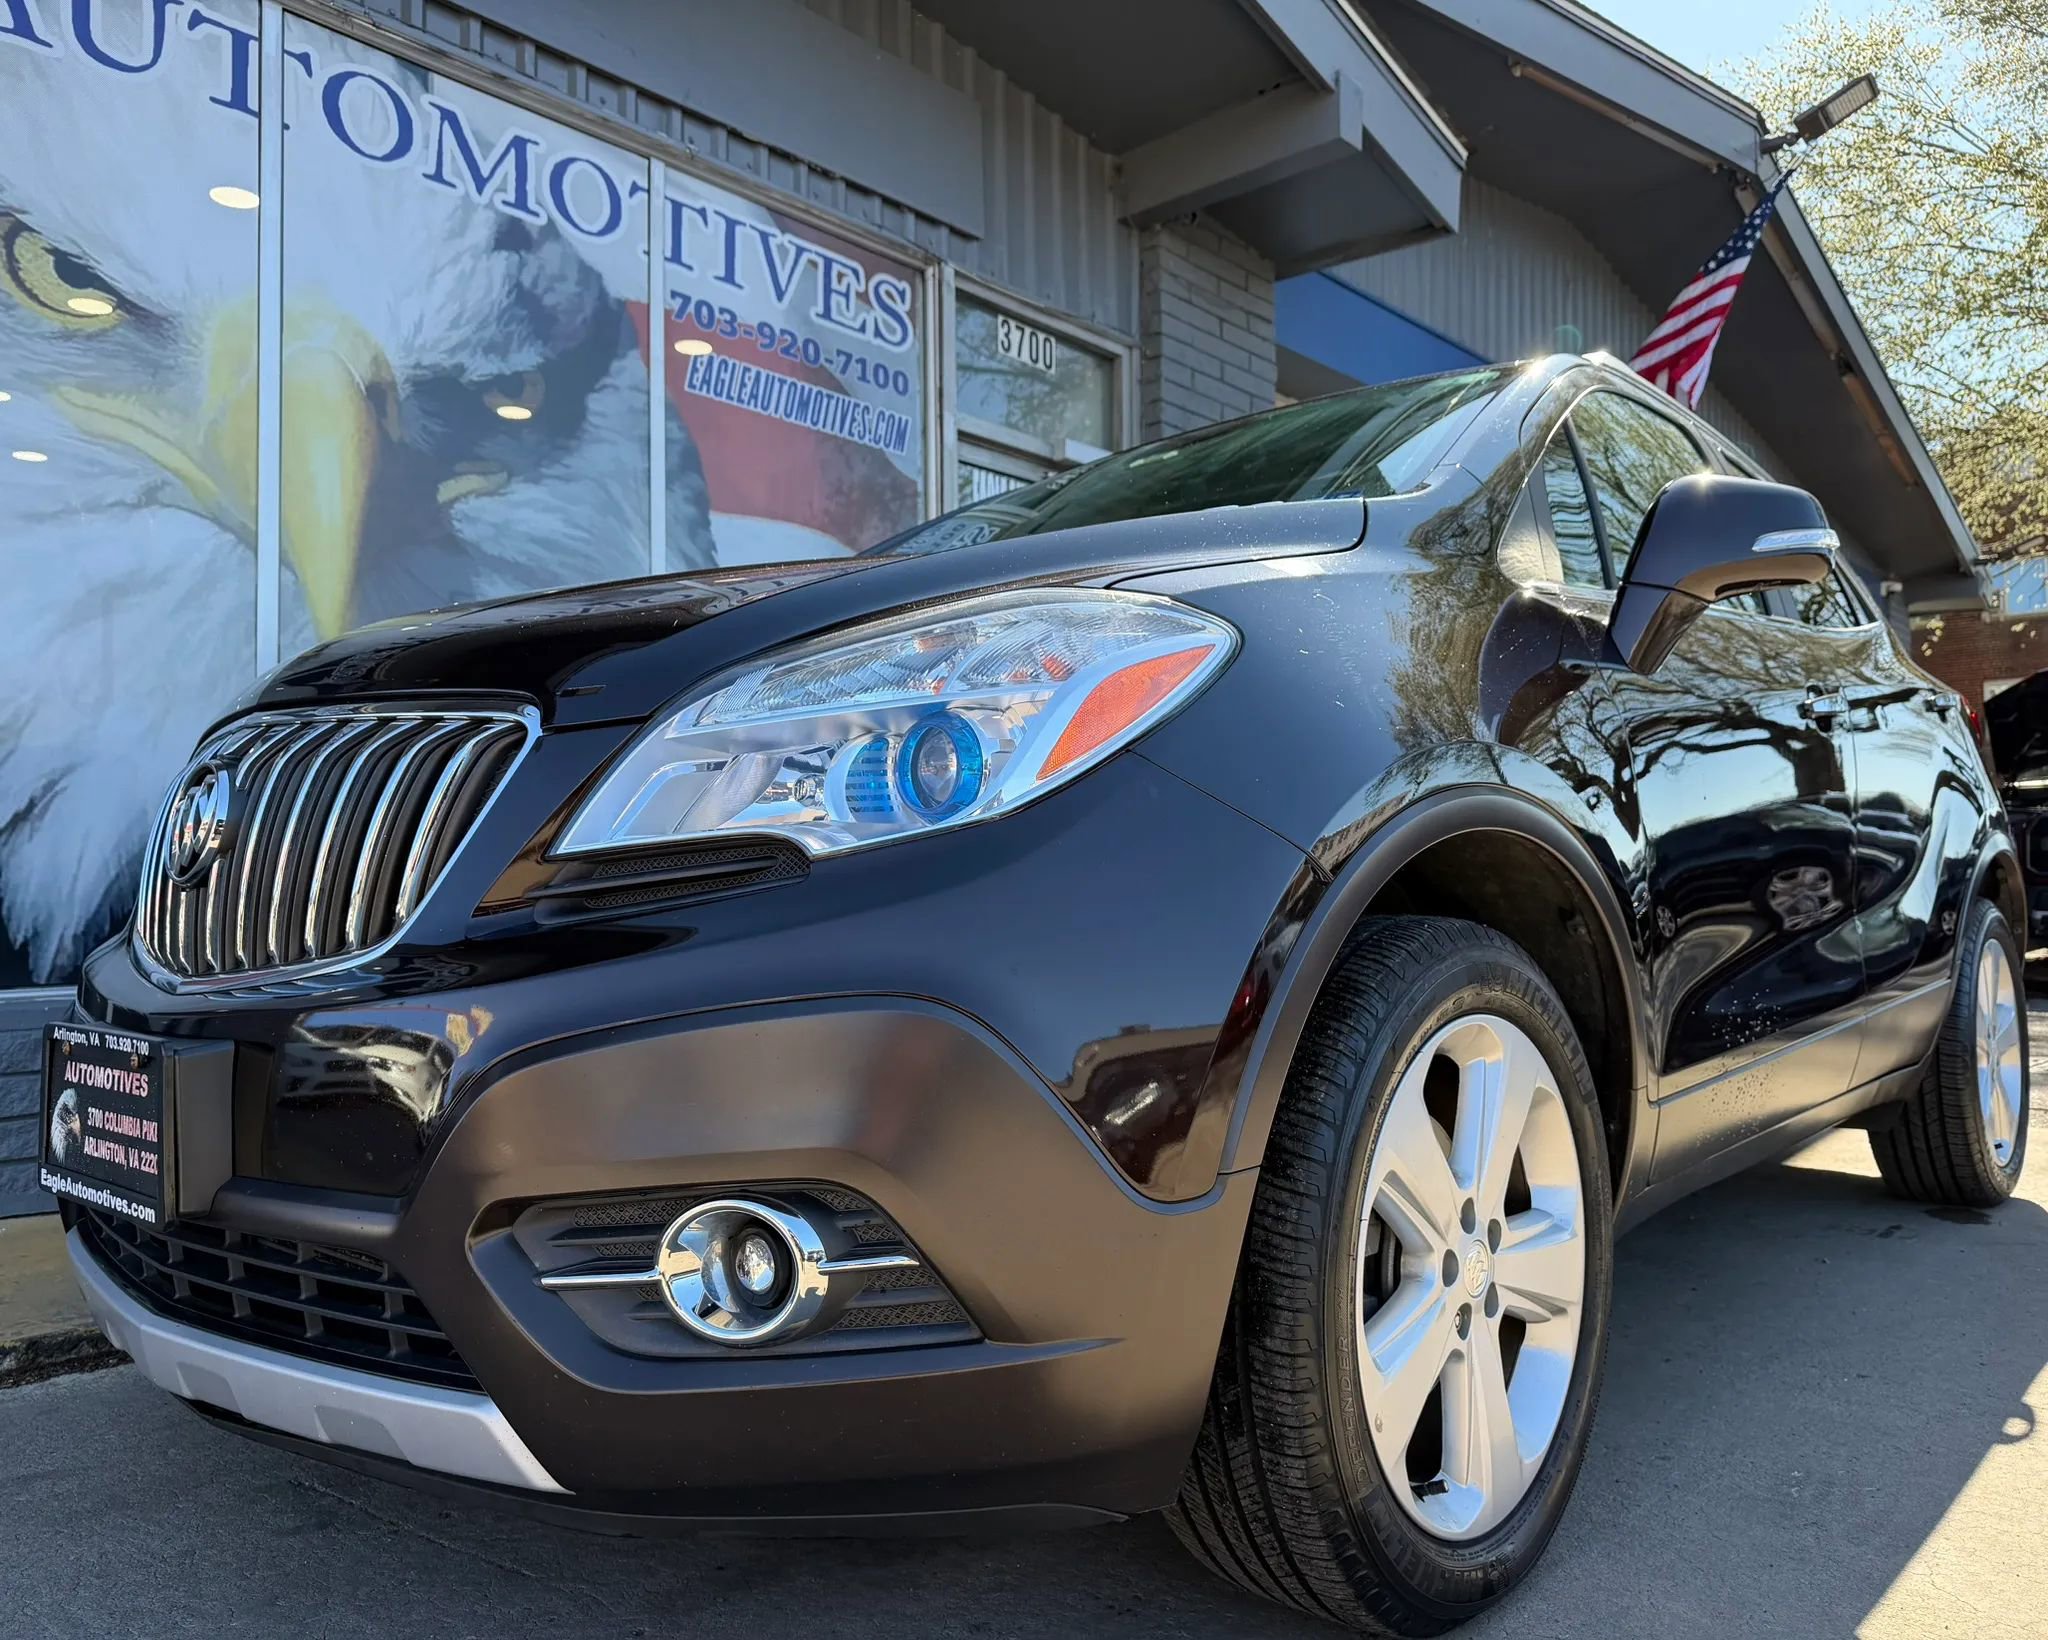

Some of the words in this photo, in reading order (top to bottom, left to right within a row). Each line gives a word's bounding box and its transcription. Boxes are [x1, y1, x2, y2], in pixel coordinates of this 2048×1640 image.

[0, 0, 914, 347] UTOMOTIVES
[669, 290, 910, 395] 703-920-7100
[1000, 319, 1054, 371] 3700
[685, 357, 910, 453] EAGLEAUTOMOTIVES.COM
[53, 1026, 89, 1046] Arlington,
[89, 1031, 101, 1047] VA
[105, 1034, 150, 1056] 703.920.7100
[64, 1060, 149, 1098] AUTOMOTIVES
[87, 1106, 104, 1129] 3700
[104, 1110, 141, 1139] COLUMBIA
[83, 1135, 128, 1171] ARLINGTON,
[128, 1146, 140, 1170] VA
[41, 1168, 156, 1223] EagleAutomotives.com
[1336, 1335, 1370, 1490] DEFENDER
